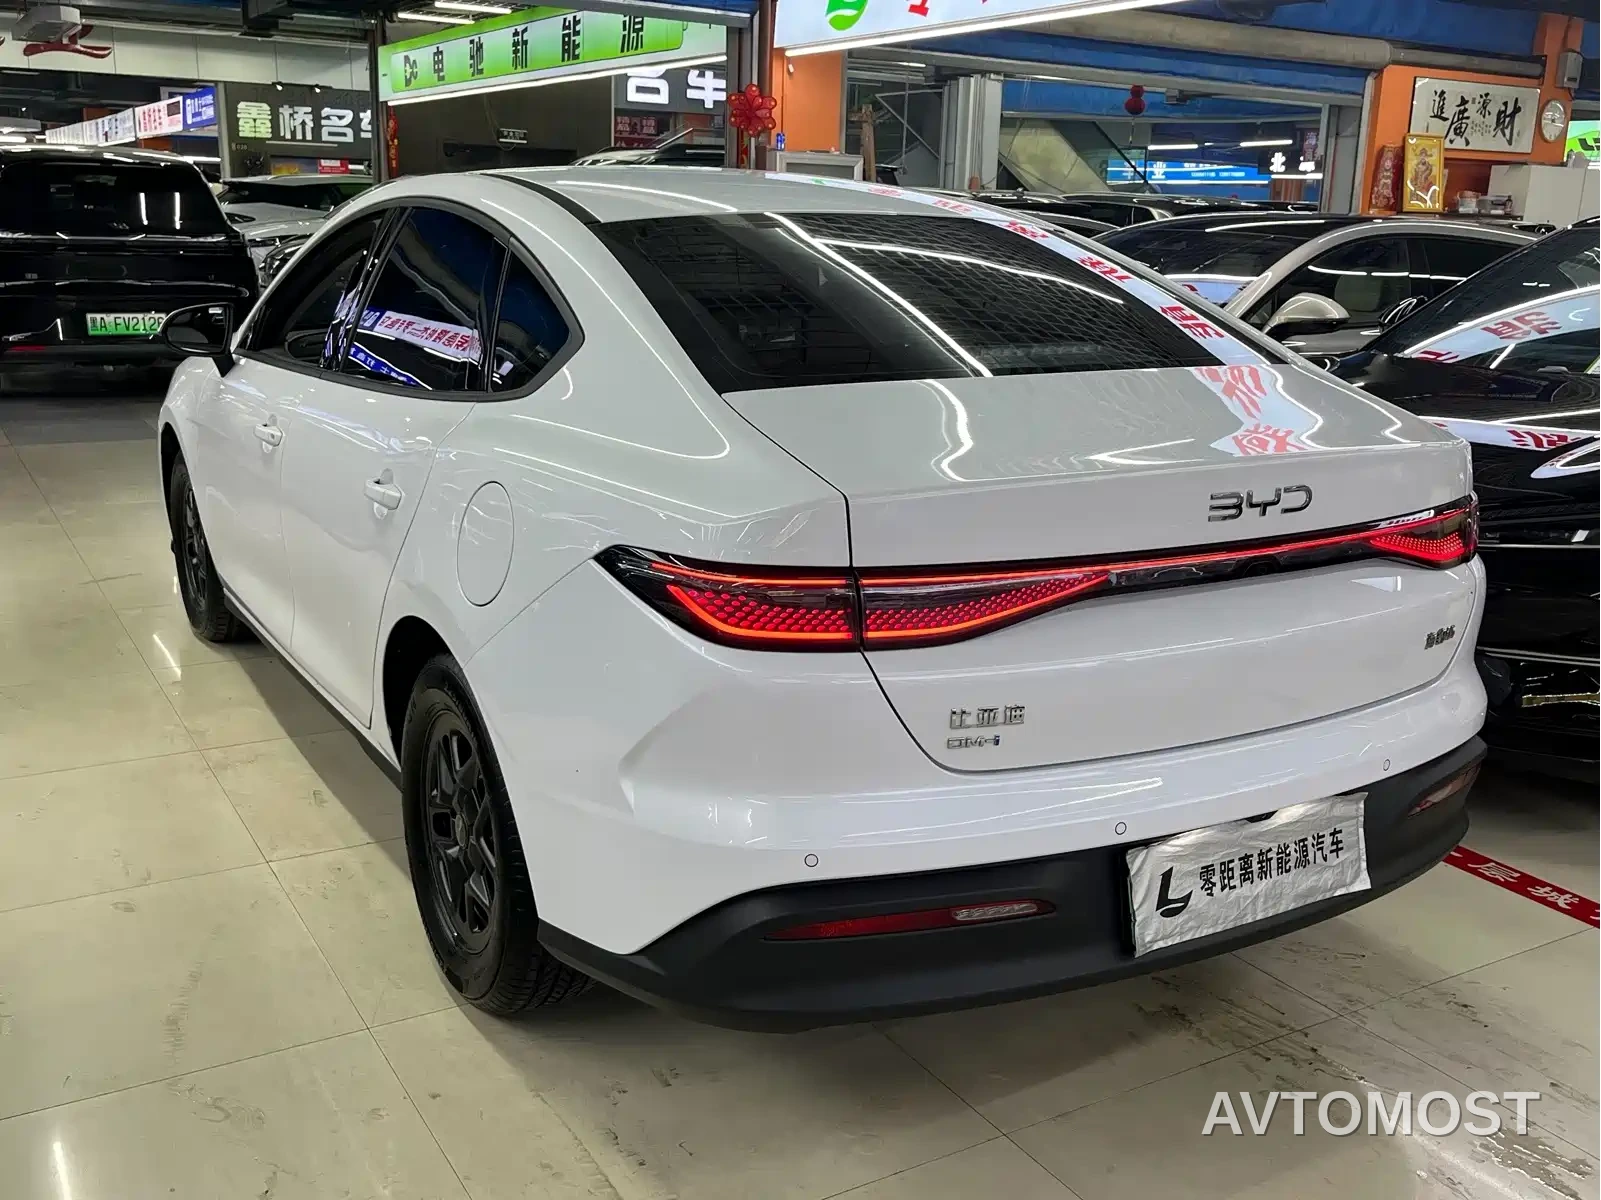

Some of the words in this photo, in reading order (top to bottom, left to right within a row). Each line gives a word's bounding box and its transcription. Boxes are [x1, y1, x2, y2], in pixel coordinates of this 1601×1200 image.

[433, 15, 645, 82] 电驰新能源
[1207, 484, 1313, 523] BYD
[949, 704, 1026, 730] 比亚迪
[1199, 827, 1345, 898] 零距离新能源汽车
